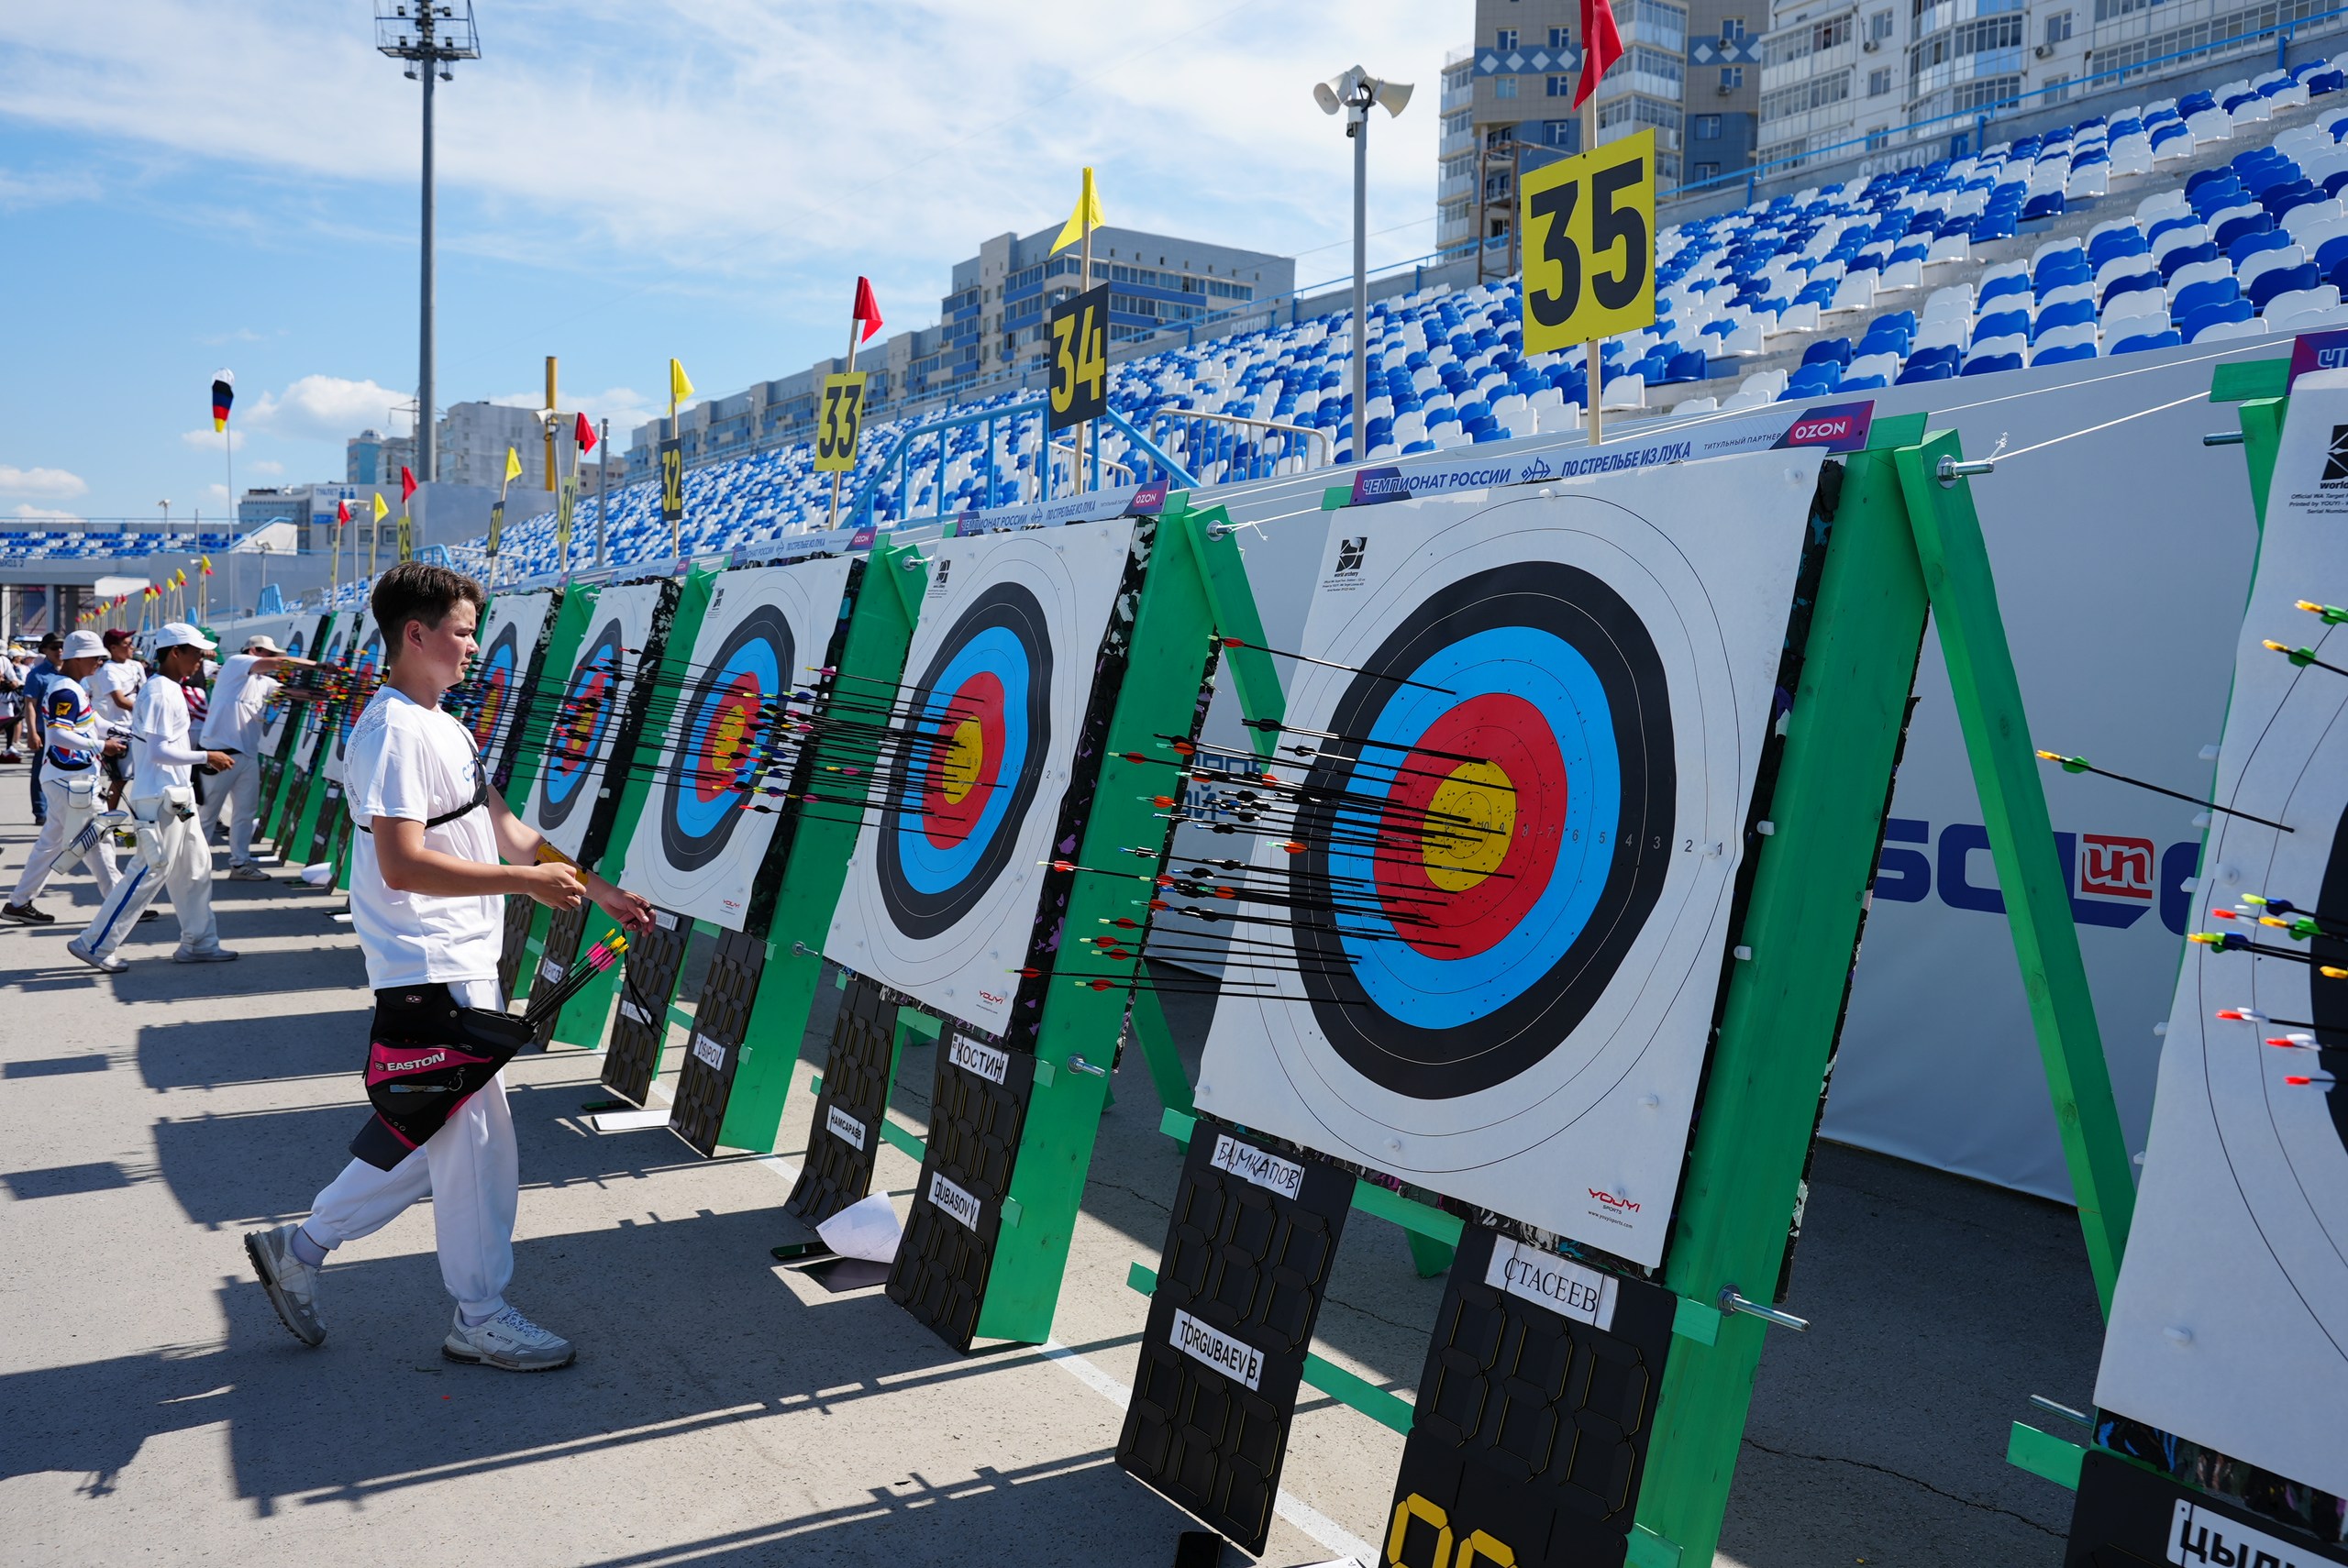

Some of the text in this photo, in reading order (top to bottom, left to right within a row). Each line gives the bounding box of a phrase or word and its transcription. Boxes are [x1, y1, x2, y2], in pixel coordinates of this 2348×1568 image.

[1529, 157, 1647, 327] 35
[1050, 304, 1105, 414] 34
[819, 384, 862, 459] 33
[1794, 421, 1847, 440] OZON
[1703, 433, 1782, 450] ТИТУЛЬНЫЙ ПАРТНЕР
[661, 448, 681, 513] 32
[1362, 441, 1691, 495] ЧЕМПИОНАТ РОССИИ ПО СТРЕЛЬБЕ ИЗ ЛУКА
[559, 484, 574, 535] 31
[1135, 493, 1157, 503] OZON
[487, 507, 503, 552] 30
[854, 535, 869, 544] OZON
[960, 516, 1001, 530] ЧЕМПИОНАТ
[1001, 513, 1028, 526] РОССИИ
[399, 523, 412, 561] 29
[1572, 829, 1579, 842] 6
[1599, 832, 1606, 845] 5
[1625, 834, 1633, 847] 4
[1653, 836, 1661, 850] 3
[1684, 839, 1693, 853] 2
[387, 1052, 446, 1072] EASTON
[956, 1042, 1005, 1080] КОСТИН
[934, 1180, 970, 1218] DUBASOV
[1588, 1187, 1641, 1213] YOUYI
[1602, 1204, 1623, 1215] SPORTS
[1504, 1256, 1599, 1313] СТАСЕЕВ
[1180, 1320, 1248, 1374] TORGUBAEV
